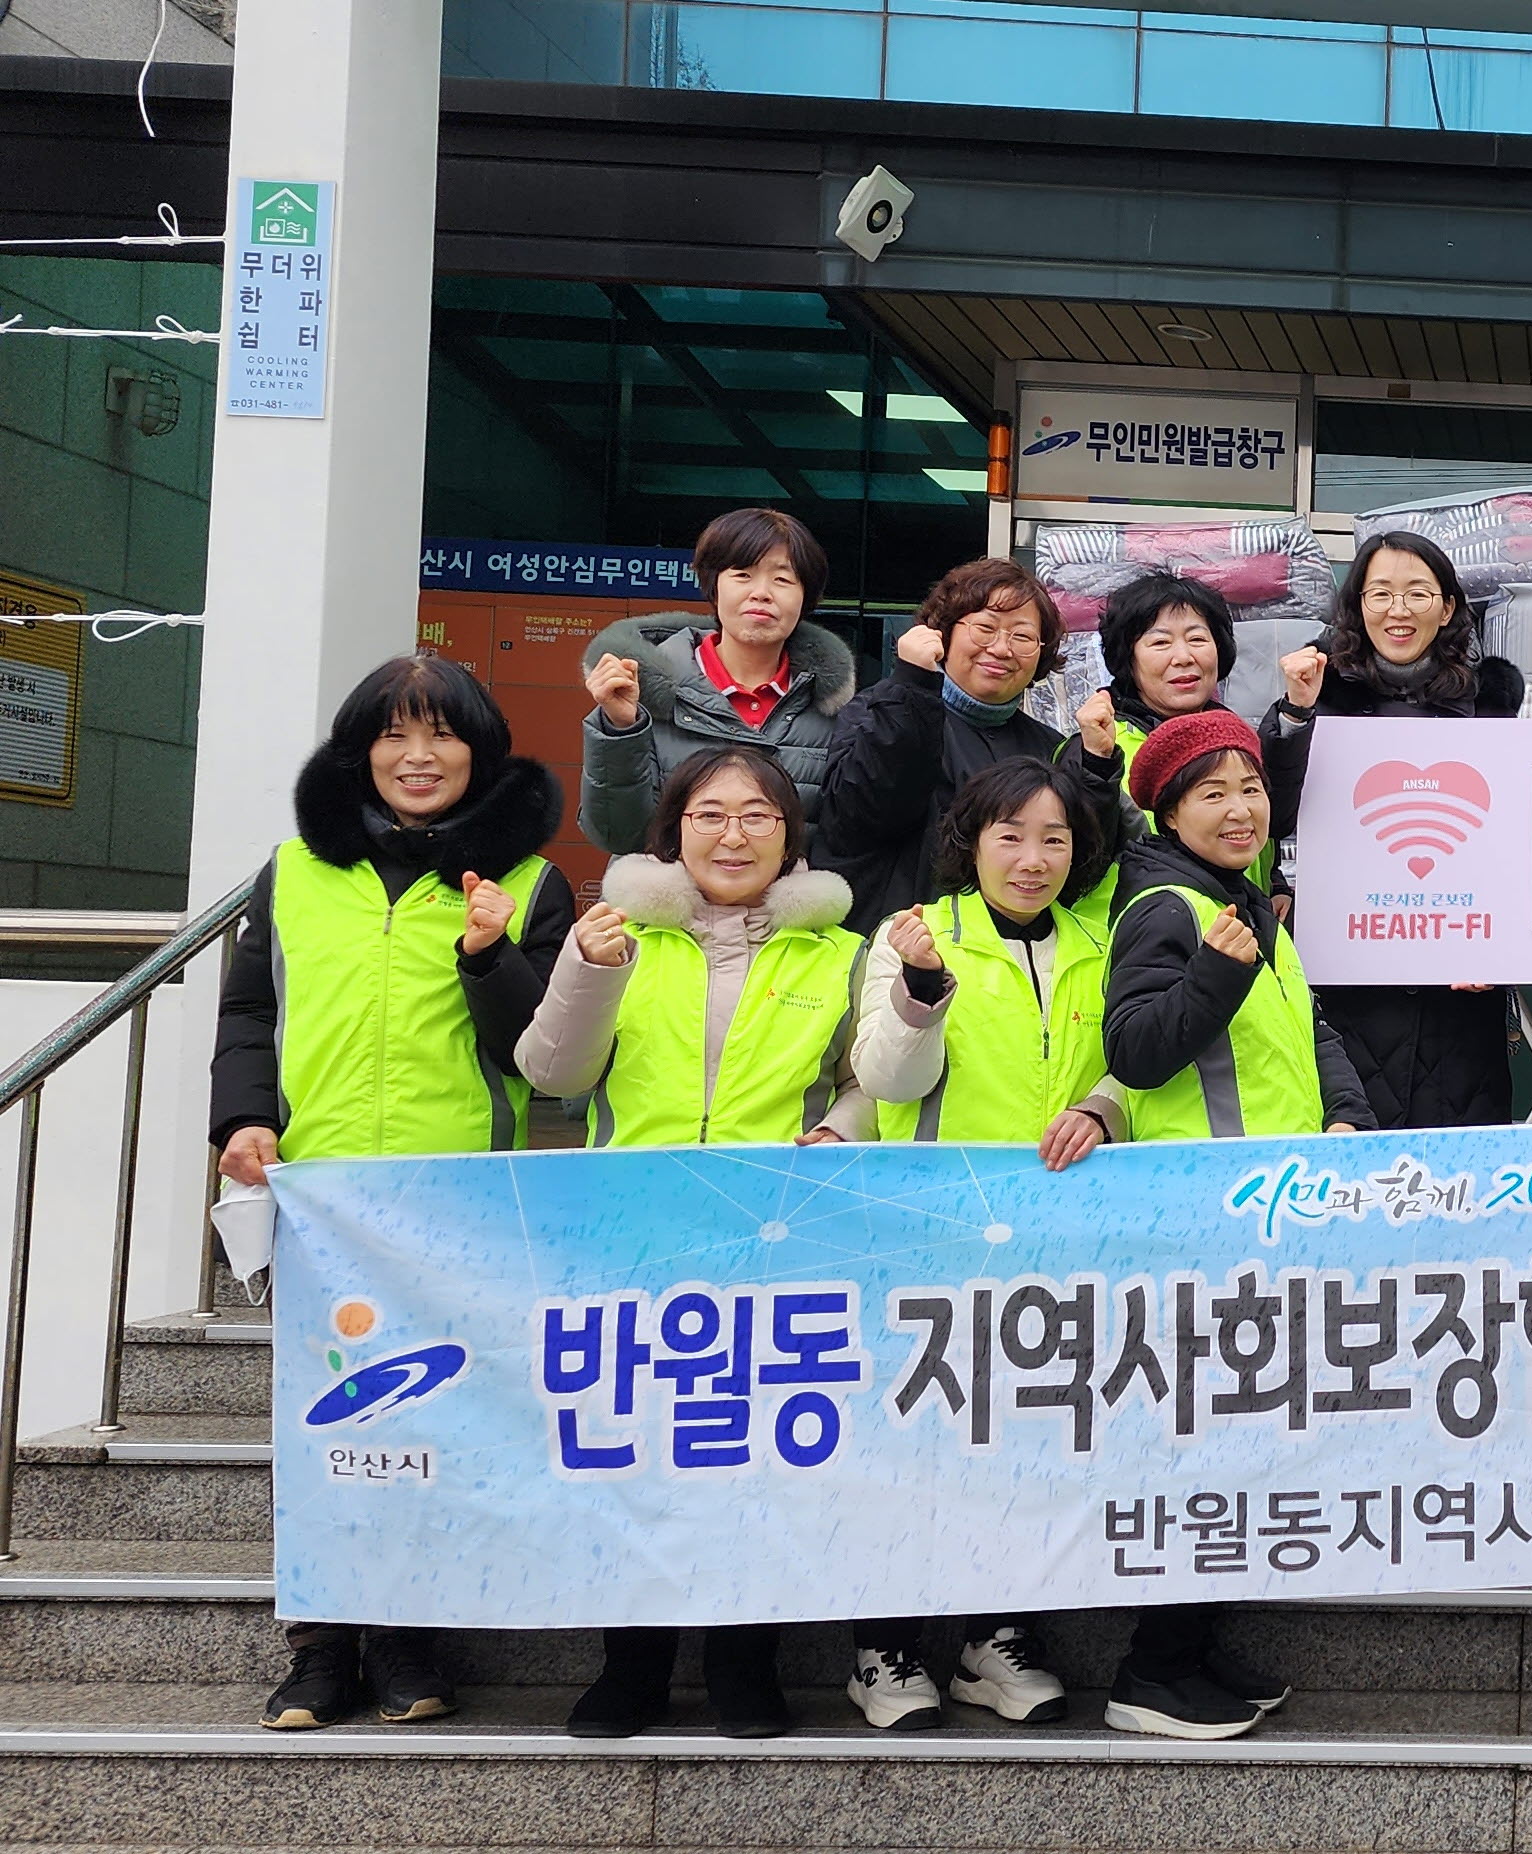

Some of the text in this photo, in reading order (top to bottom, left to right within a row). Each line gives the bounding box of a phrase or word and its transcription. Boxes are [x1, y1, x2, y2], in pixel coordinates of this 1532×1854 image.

[240, 251, 322, 281] 무더위
[246, 368, 309, 378] WARMING
[247, 356, 308, 366] COOLING
[249, 380, 303, 389] CENTER
[1086, 421, 1286, 470] 무인민원발급창구
[1403, 779, 1440, 790] ANSAN
[1348, 913, 1492, 940] HEART-FI
[1230, 1160, 1367, 1238] 시민과
[1372, 1160, 1473, 1218] 함께,
[542, 1290, 862, 1471] 반월동
[328, 1447, 432, 1480] 안산시
